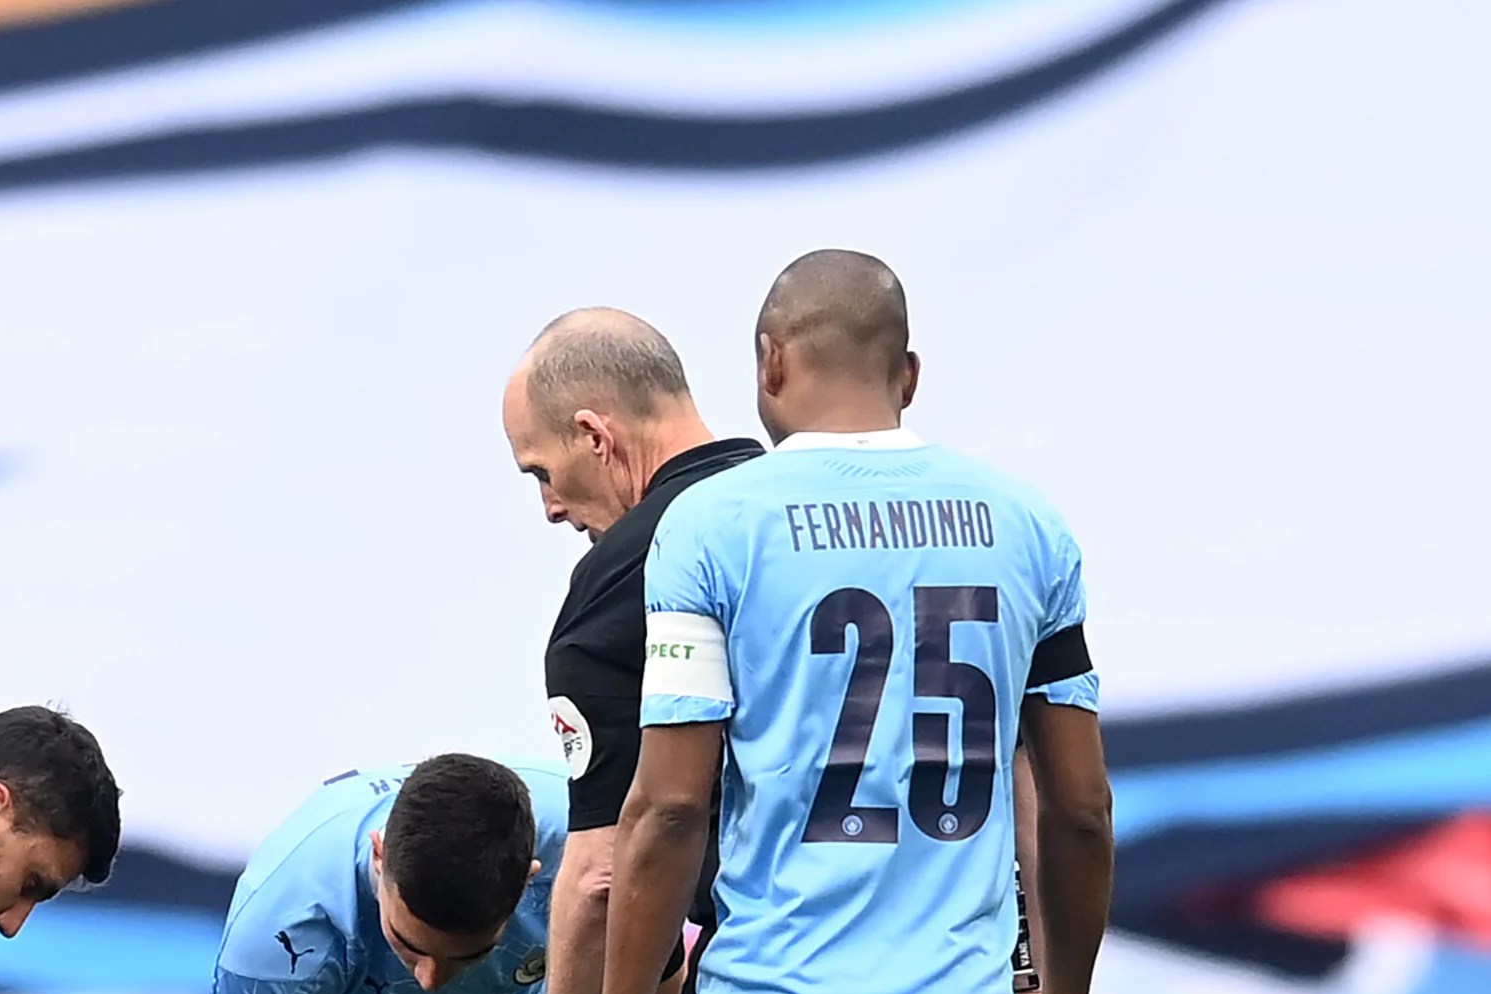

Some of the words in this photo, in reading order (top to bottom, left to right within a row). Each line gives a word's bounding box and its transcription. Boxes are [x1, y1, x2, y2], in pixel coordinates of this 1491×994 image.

[785, 499, 995, 552] FERNANDINHO
[647, 643, 696, 660] PECT
[800, 585, 999, 843] 25
